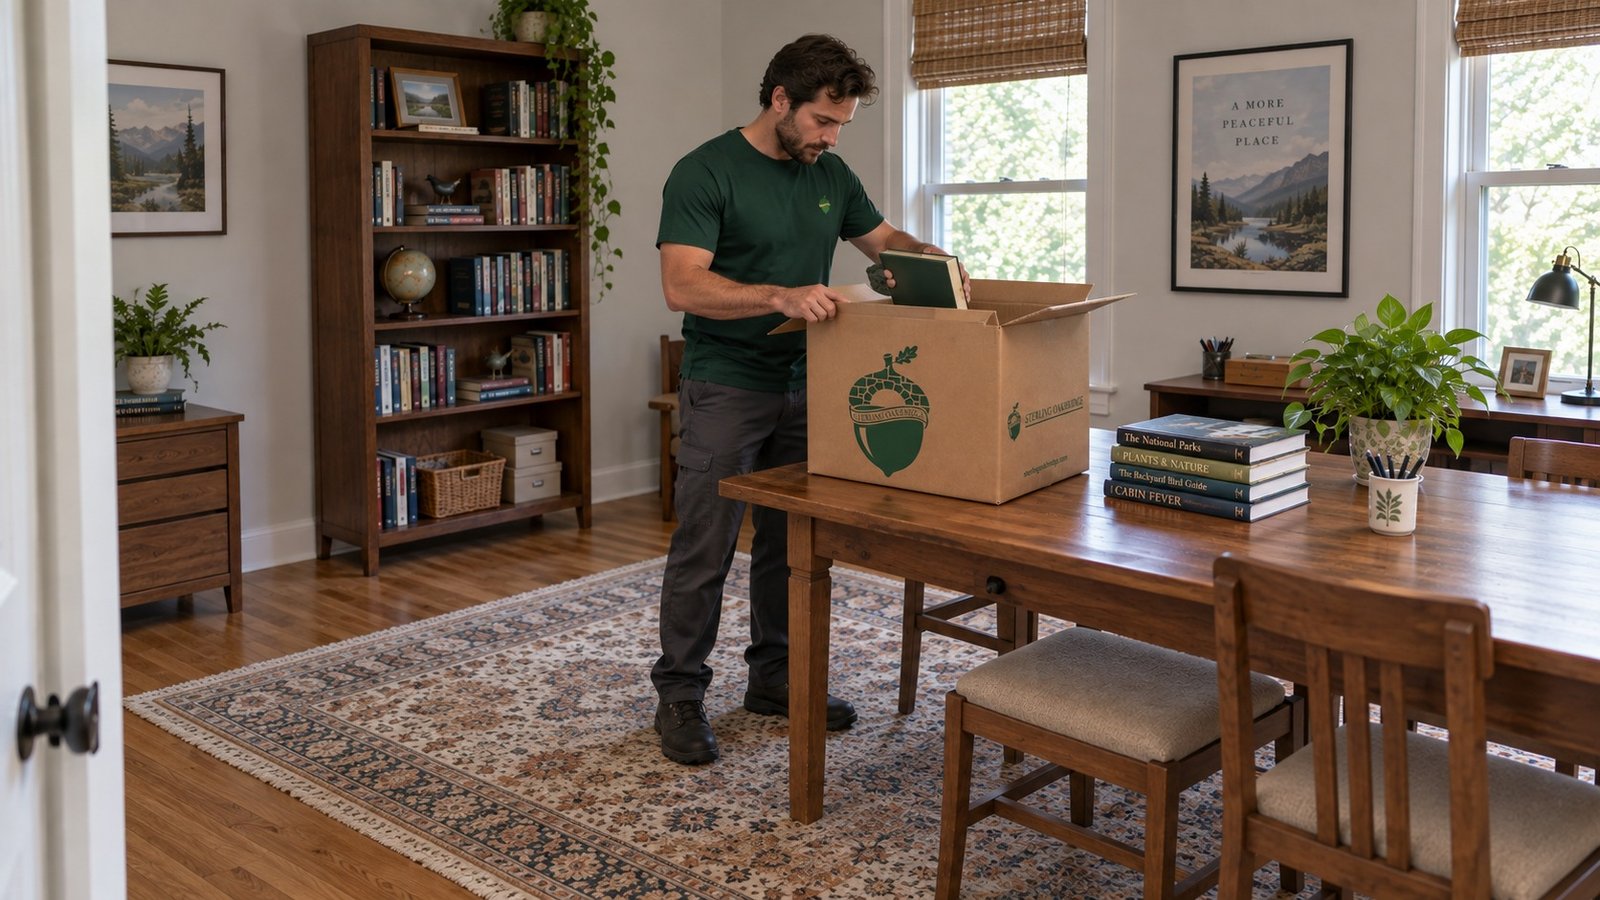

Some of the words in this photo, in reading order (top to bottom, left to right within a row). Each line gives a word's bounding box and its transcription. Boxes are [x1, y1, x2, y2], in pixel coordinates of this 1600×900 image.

[1232, 102, 1239, 110] A
[1246, 98, 1284, 110] MORE
[1222, 116, 1294, 129] PEACEFUL
[1235, 135, 1279, 146] PLACE
[1124, 432, 1140, 443] The
[1142, 435, 1177, 449] National
[1179, 440, 1202, 452] Parks
[1122, 451, 1159, 466] PLANTS
[1160, 457, 1168, 467] &
[1170, 459, 1210, 473] NATURE
[1118, 468, 1132, 478] The
[1167, 476, 1183, 487] Bird
[1184, 479, 1208, 491] Guide
[1114, 485, 1146, 499] CABIN
[1149, 491, 1182, 506] FEVER
